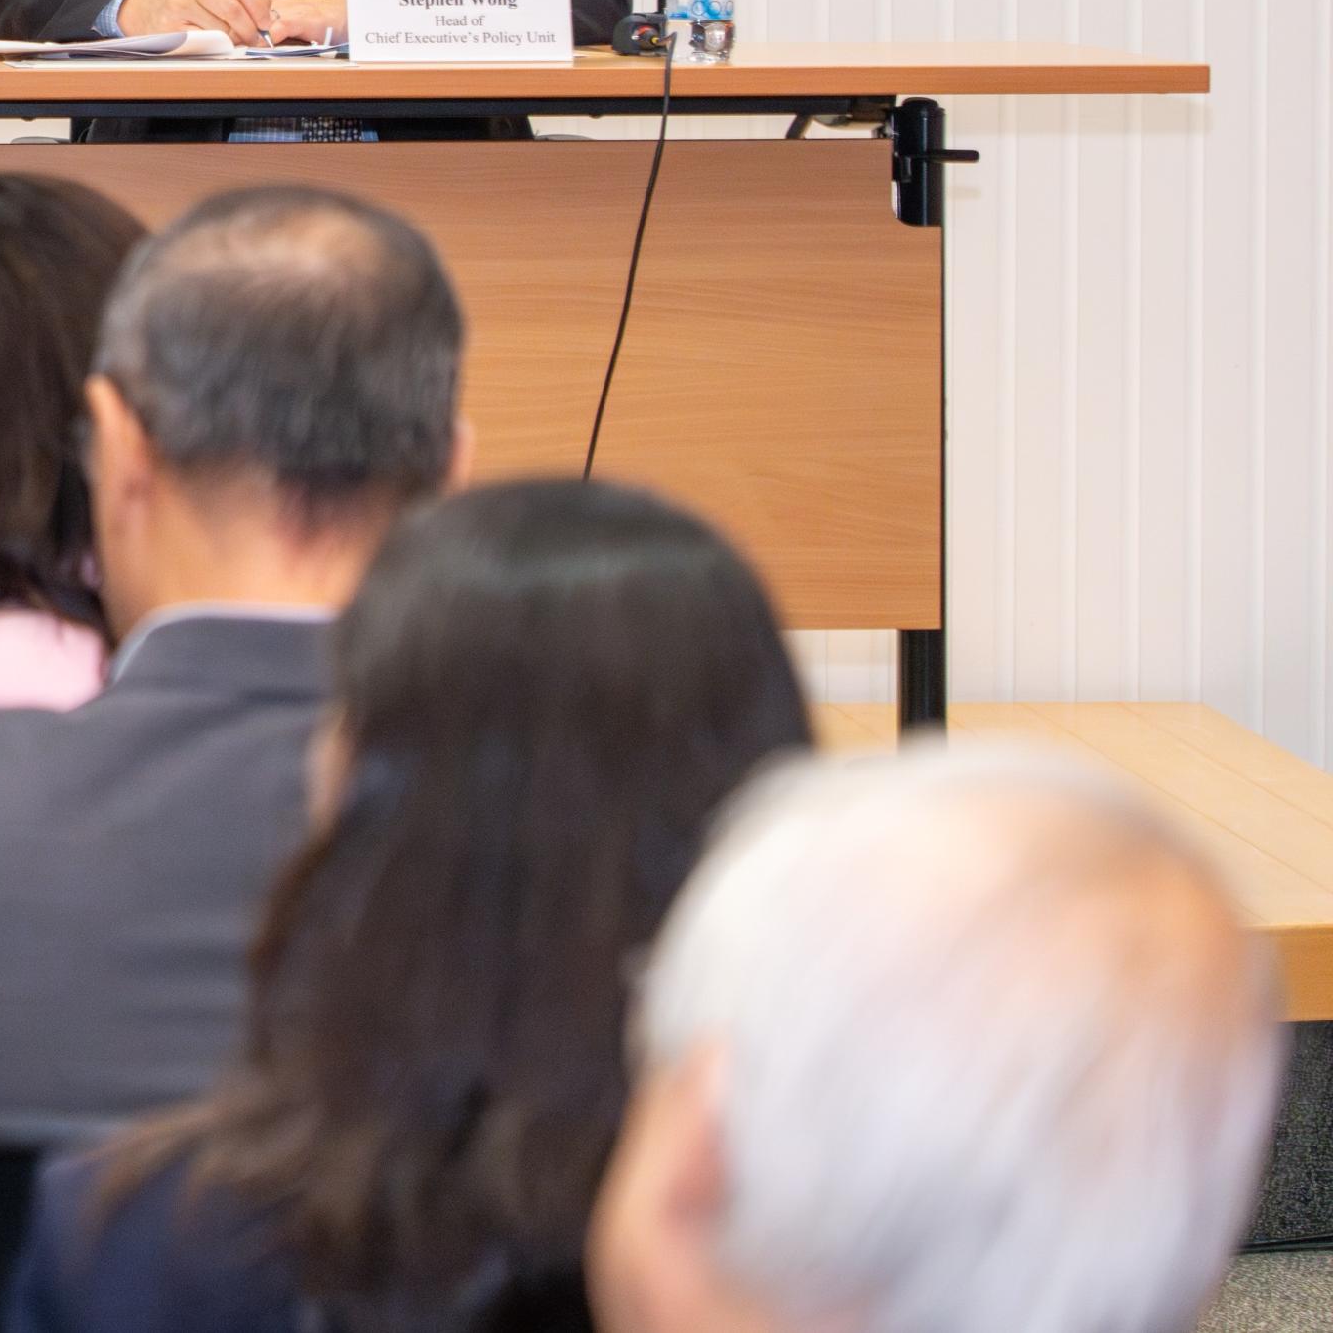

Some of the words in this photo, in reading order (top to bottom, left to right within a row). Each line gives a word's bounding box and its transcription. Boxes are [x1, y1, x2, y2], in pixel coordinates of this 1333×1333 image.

[435, 15, 467, 26] Head
[471, 15, 485, 26] of
[365, 32, 401, 44] Chief
[482, 32, 523, 45] Policy
[526, 31, 556, 43] Unit
